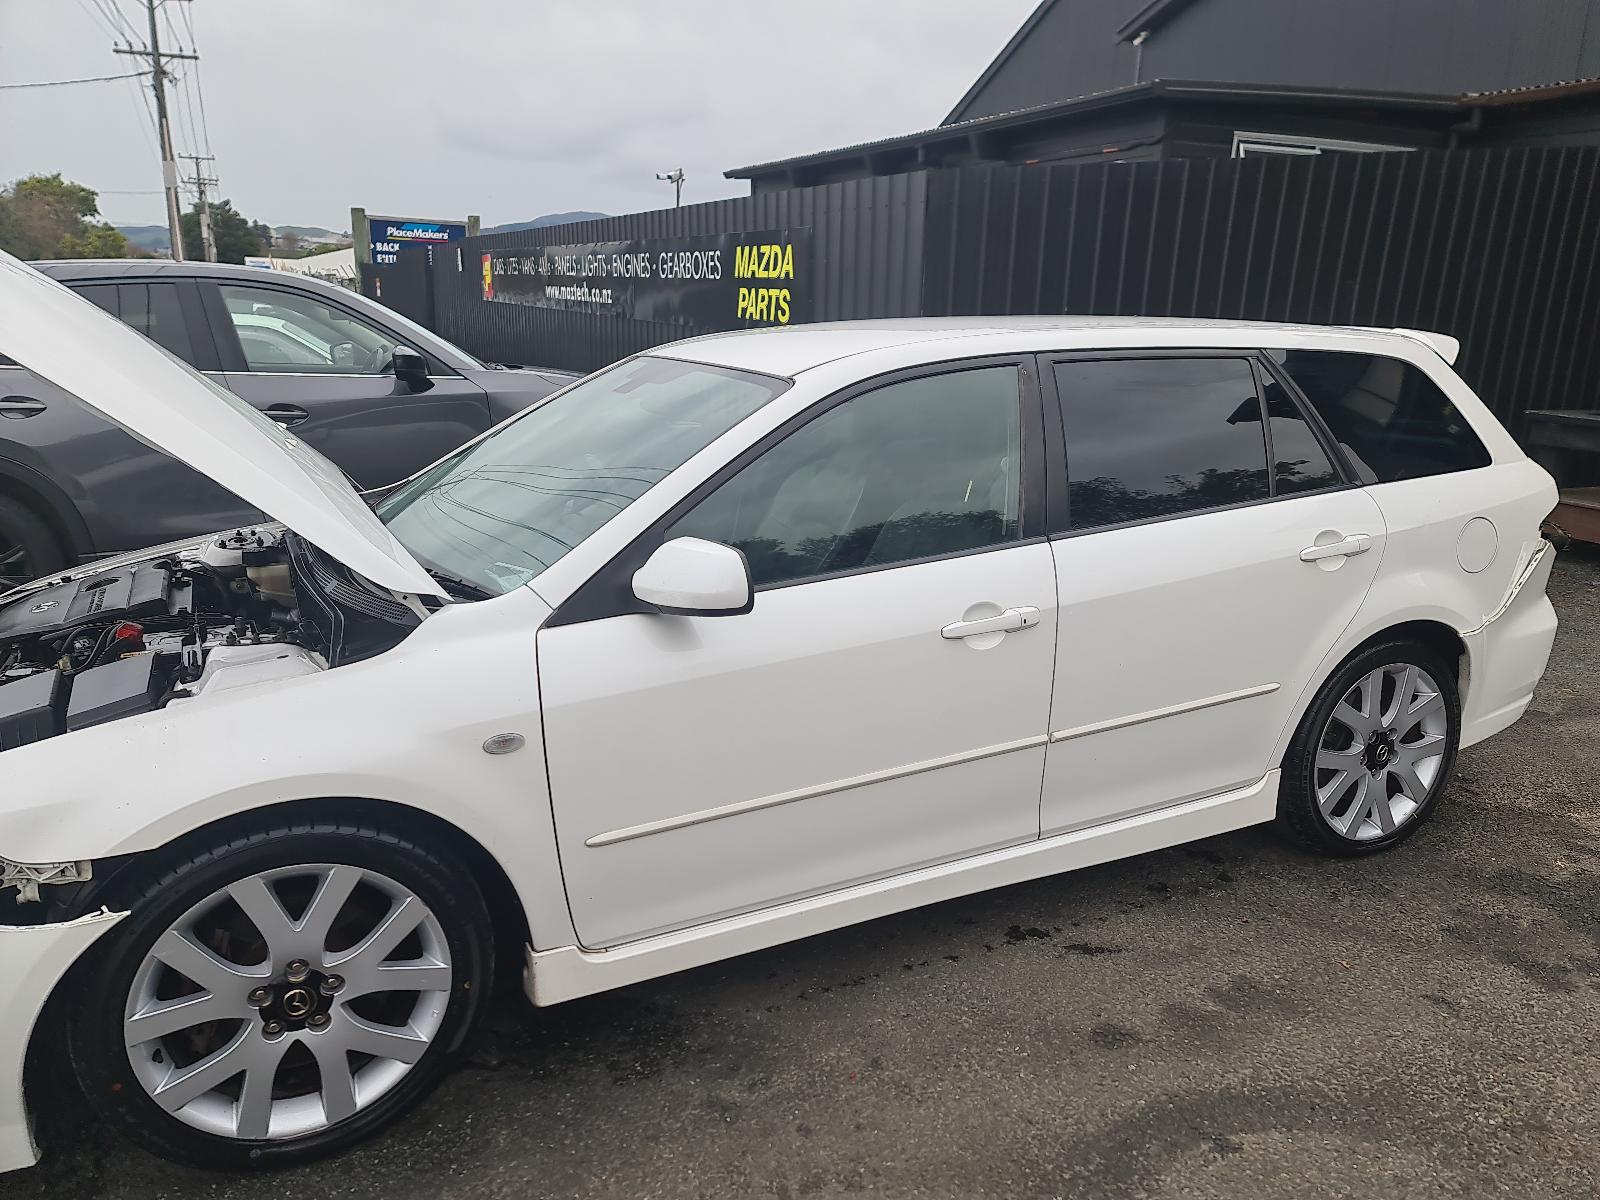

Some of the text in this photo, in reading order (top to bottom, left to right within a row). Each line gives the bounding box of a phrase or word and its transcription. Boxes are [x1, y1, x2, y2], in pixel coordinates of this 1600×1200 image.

[375, 242, 400, 253] BACK
[386, 226, 449, 240] PlaceMakers
[555, 254, 577, 276] PANELS
[582, 253, 607, 277] LIGHTS
[612, 252, 651, 279] ENGINES
[659, 250, 722, 280] GEARBOXES
[734, 244, 794, 280] MAZDA
[737, 287, 792, 325] PARTS
